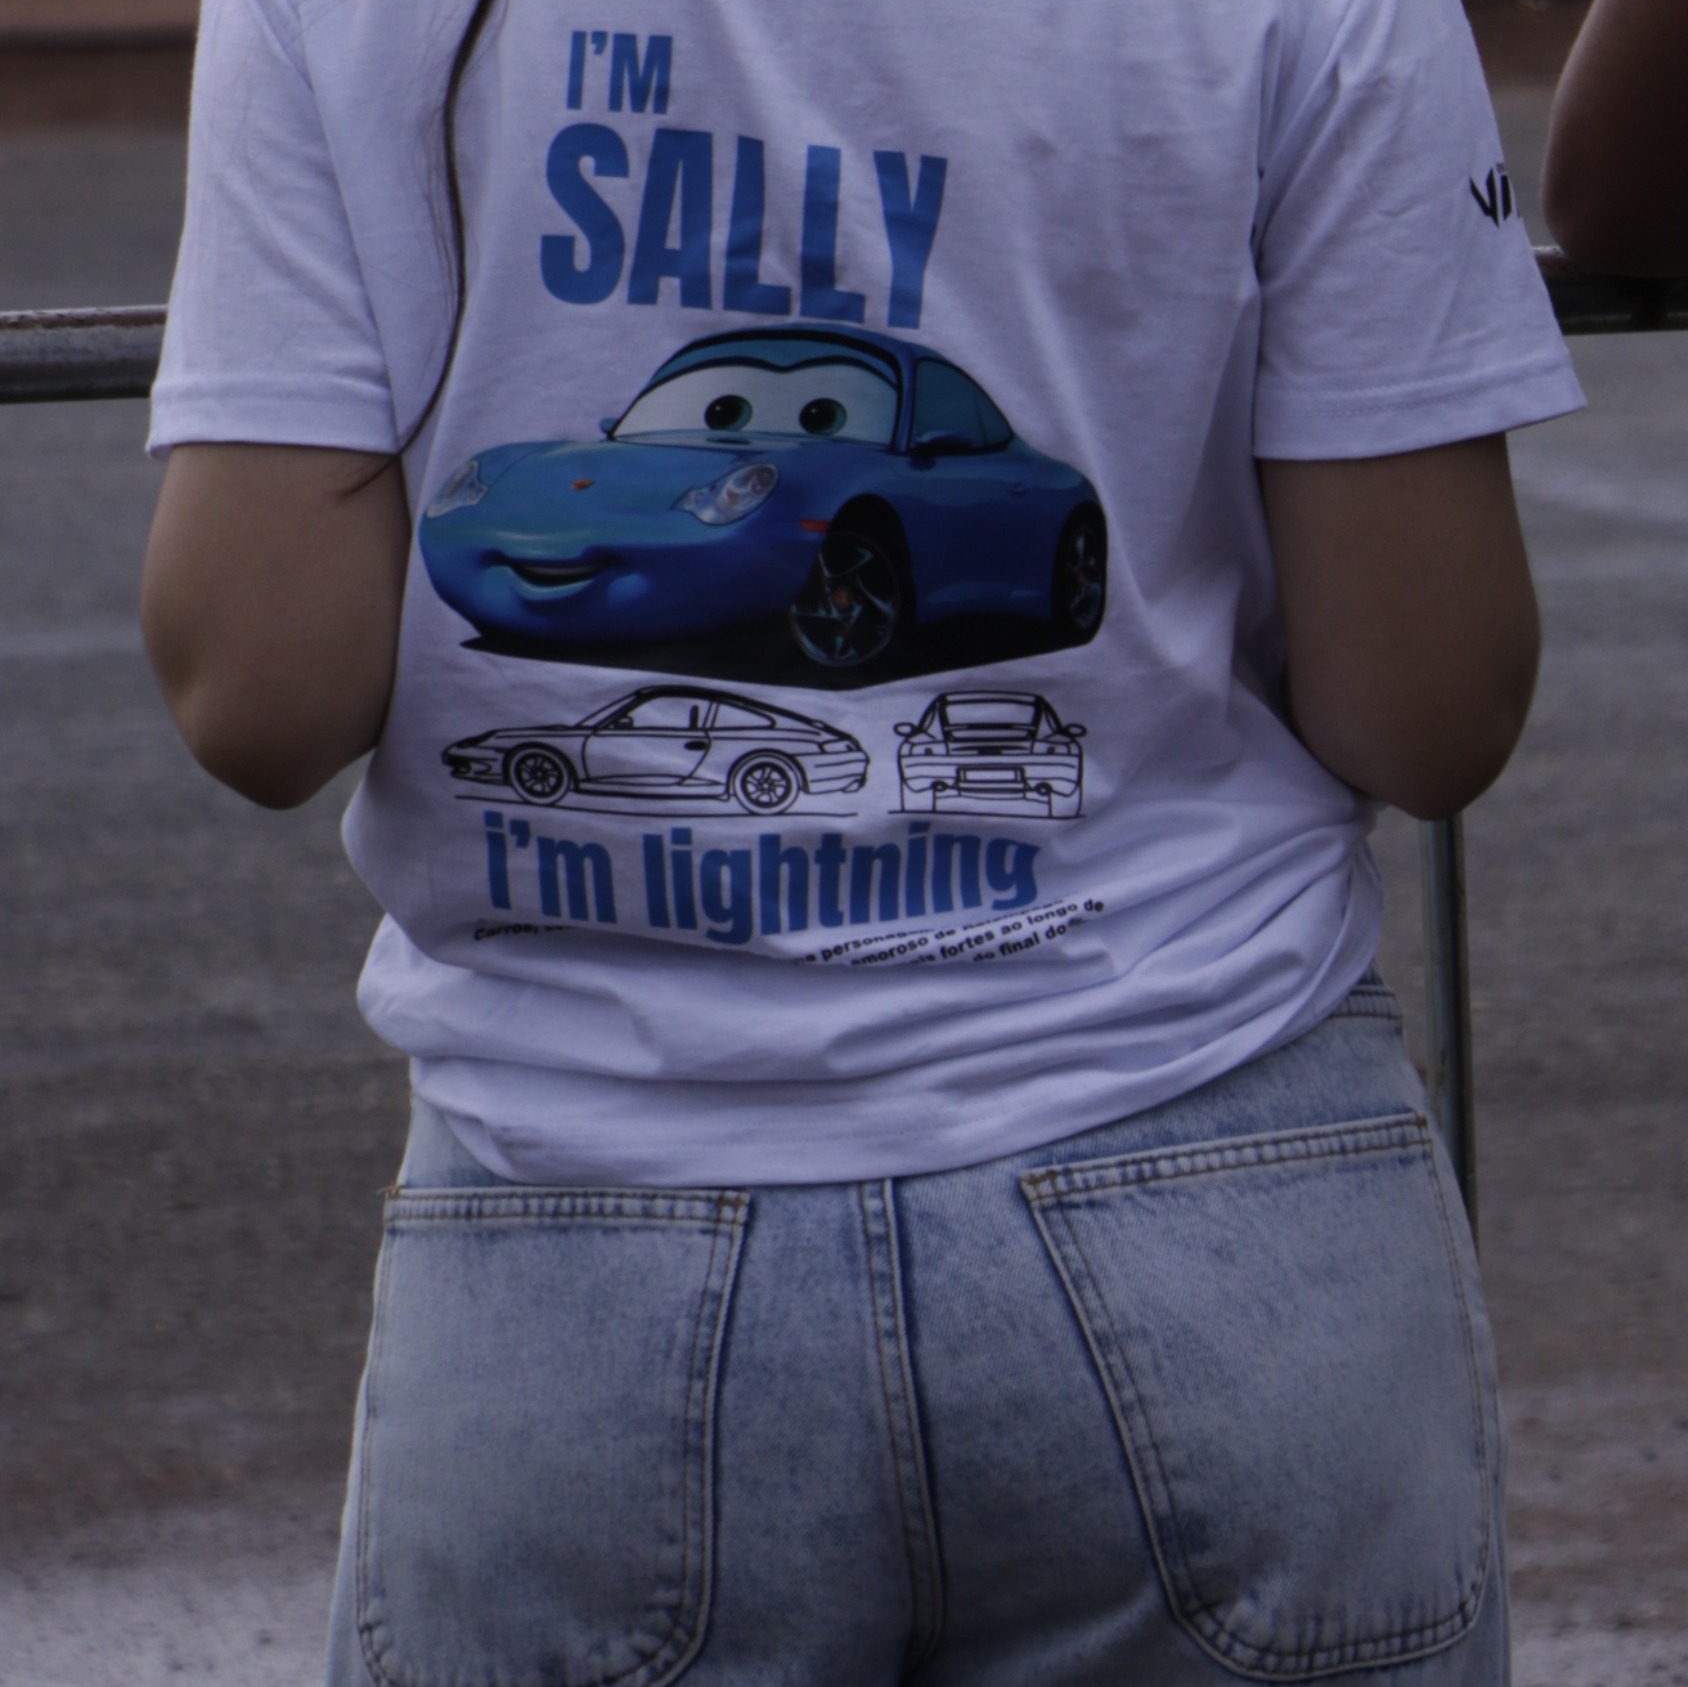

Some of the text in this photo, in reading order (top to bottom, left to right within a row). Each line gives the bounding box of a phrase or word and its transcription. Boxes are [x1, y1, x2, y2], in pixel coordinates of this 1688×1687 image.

[565, 31, 673, 114] I'M
[540, 122, 948, 330] SALLY
[484, 810, 1040, 945] i'm lightning
[940, 930, 996, 960] fortes
[1001, 920, 1023, 935] ao
[1027, 902, 1079, 925] longo
[1084, 898, 1105, 913] de
[999, 931, 1041, 957] final
[1045, 924, 1067, 940] do
